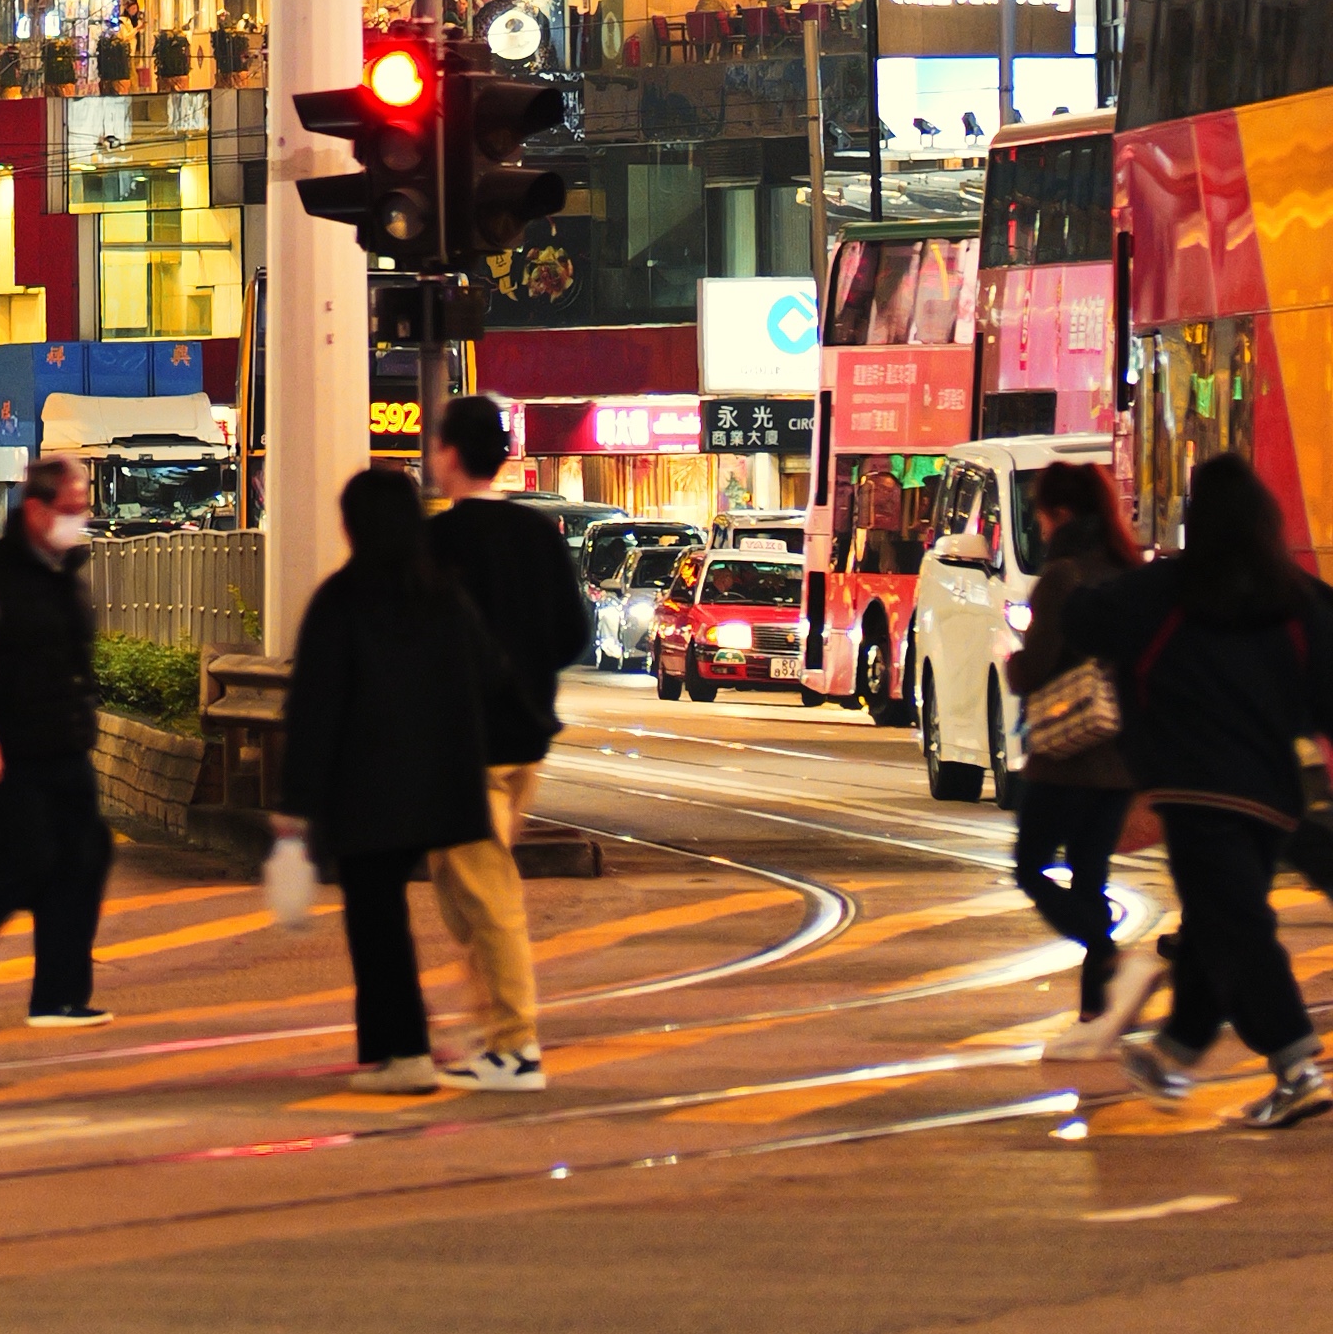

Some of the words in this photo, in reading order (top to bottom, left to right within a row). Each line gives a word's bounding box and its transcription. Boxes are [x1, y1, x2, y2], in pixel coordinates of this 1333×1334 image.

[370, 402, 422, 434] 592
[717, 405, 774, 431] 永光
[711, 429, 780, 448] 商業大廈
[744, 540, 783, 551] TAXI
